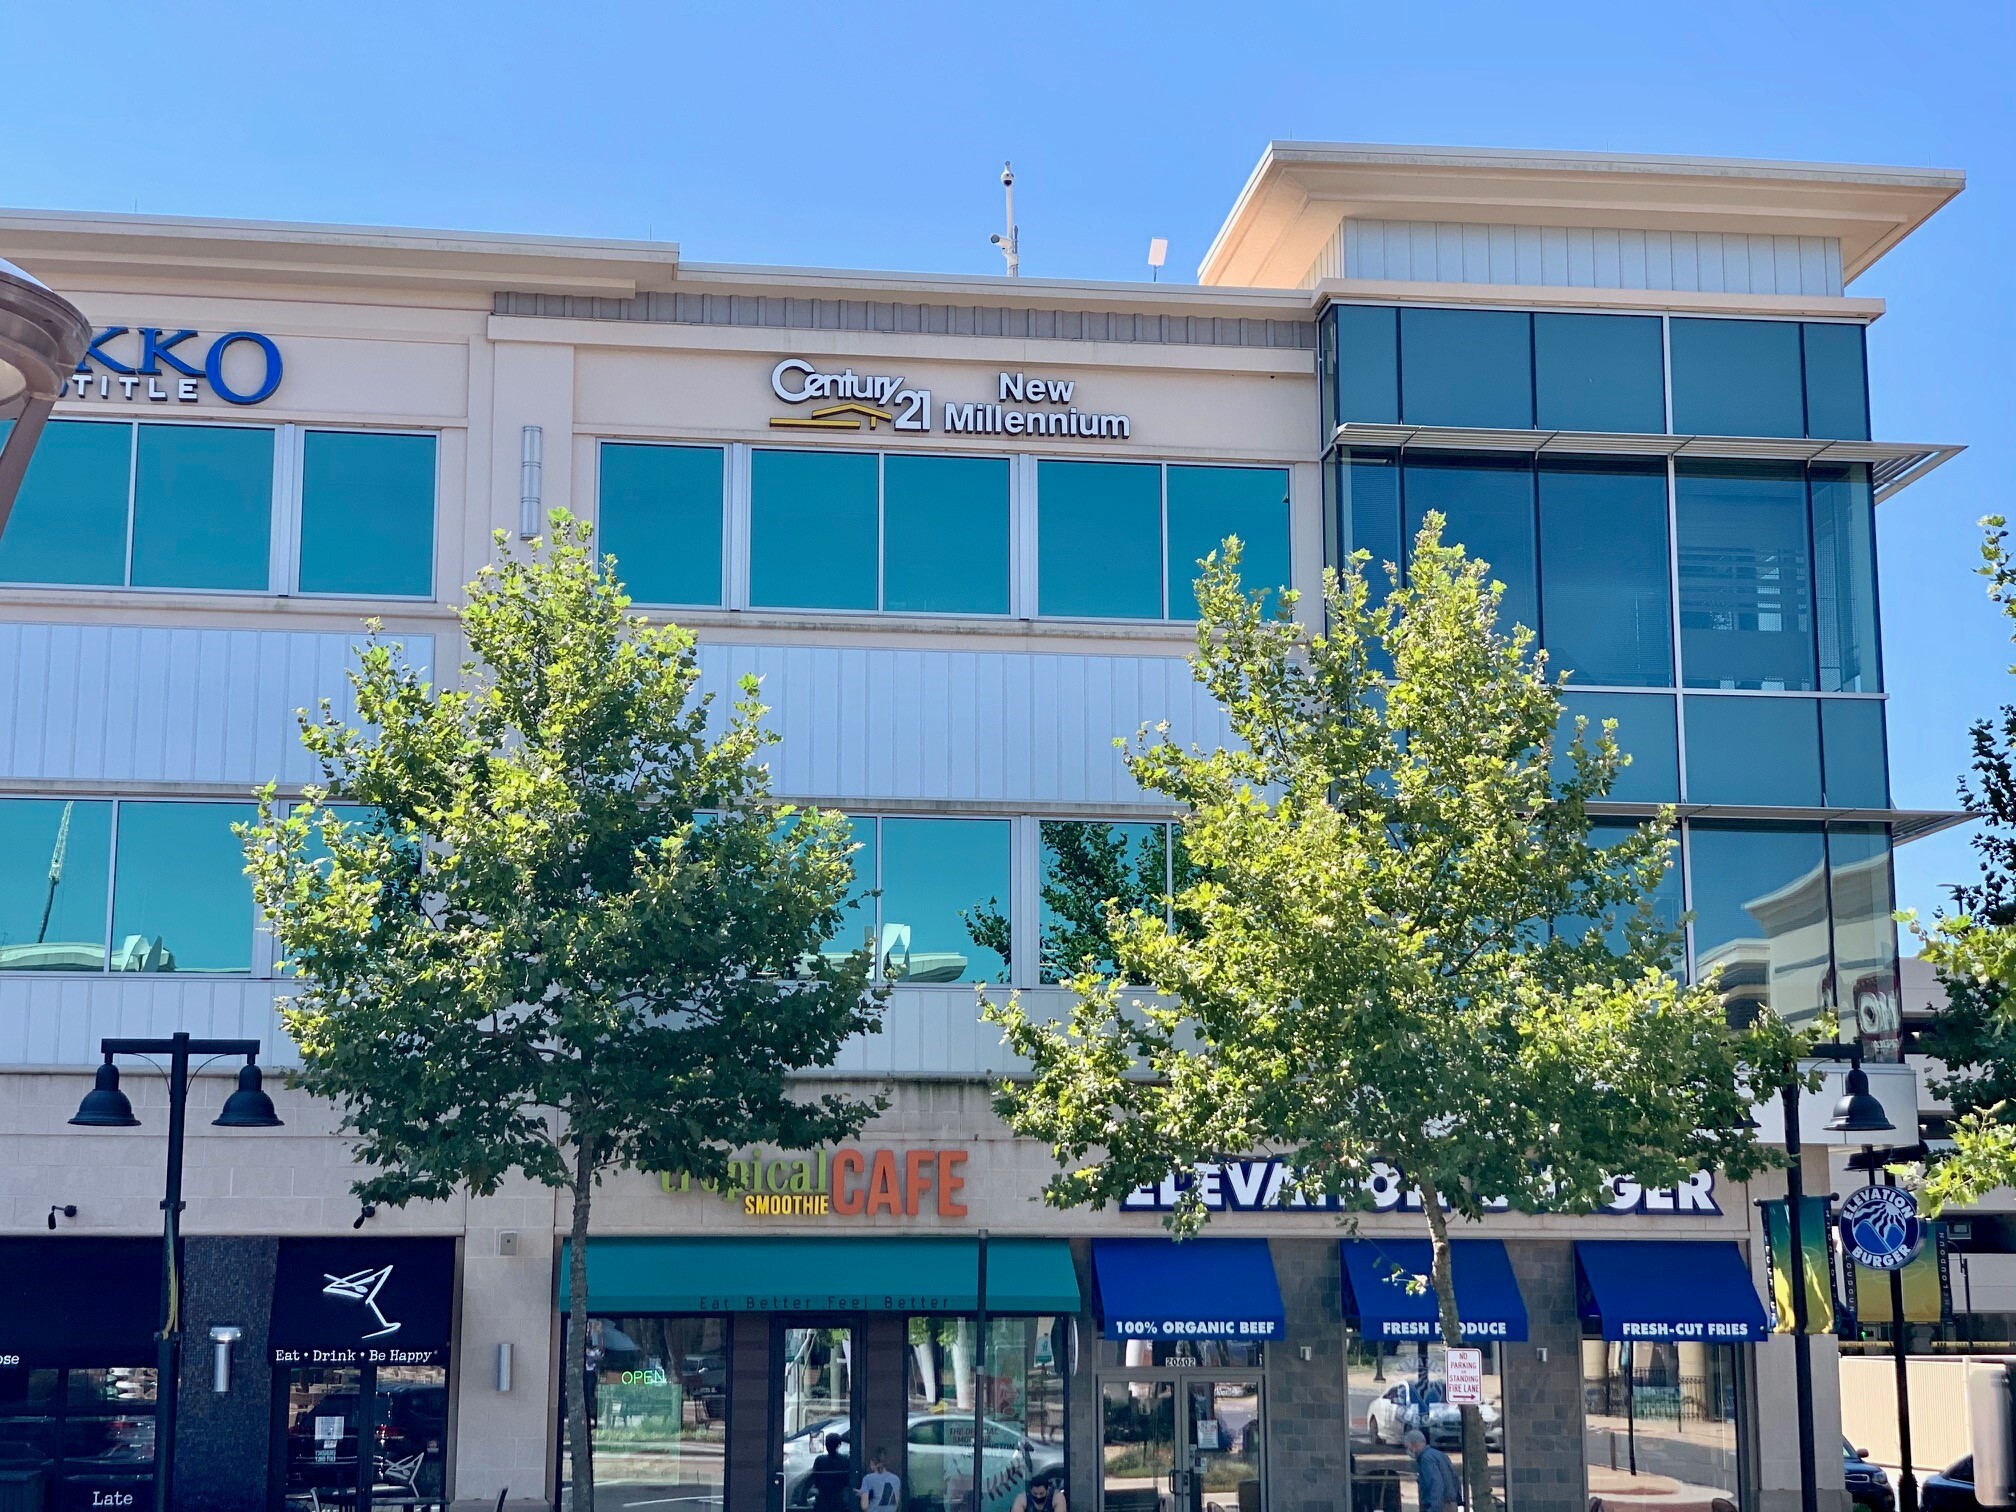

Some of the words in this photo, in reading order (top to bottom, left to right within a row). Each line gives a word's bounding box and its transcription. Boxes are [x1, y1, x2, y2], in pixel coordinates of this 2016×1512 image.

[59, 326, 284, 405] KKO
[72, 373, 198, 403] TITLE
[771, 358, 905, 407] Century
[894, 389, 931, 432] 21
[999, 372, 1075, 404] New
[944, 402, 1130, 439] Millennium
[832, 1148, 968, 1216] CAFE
[744, 1195, 829, 1215] SMOOTHIE
[1843, 1187, 1915, 1220] ELEVATION
[1852, 1244, 1911, 1268] BURGER
[699, 1296, 729, 1310] Eat
[746, 1296, 811, 1310] Better
[827, 1296, 868, 1310] Feel
[884, 1296, 949, 1310] Better
[1116, 1321, 1157, 1334] 100%
[1162, 1321, 1235, 1334] ORGANIC
[1239, 1321, 1275, 1334] BEEF
[1382, 1321, 1430, 1335] FRESH
[1434, 1321, 1507, 1335] PODUCE
[1622, 1322, 1703, 1336] FRESH-CUT
[1707, 1322, 1748, 1336] FRIES
[275, 1349, 300, 1362] Eat
[312, 1349, 356, 1362] Drink
[368, 1349, 386, 1361] Be
[1166, 1357, 1196, 1367] 20602
[1459, 1352, 1468, 1360] NO
[1450, 1361, 1477, 1369] PARKING
[621, 1370, 665, 1385] OPEN
[1449, 1375, 1479, 1383] STANDING
[1449, 1384, 1462, 1393] FIRE
[1464, 1384, 1479, 1393] LANE
[92, 1490, 133, 1506] Late
